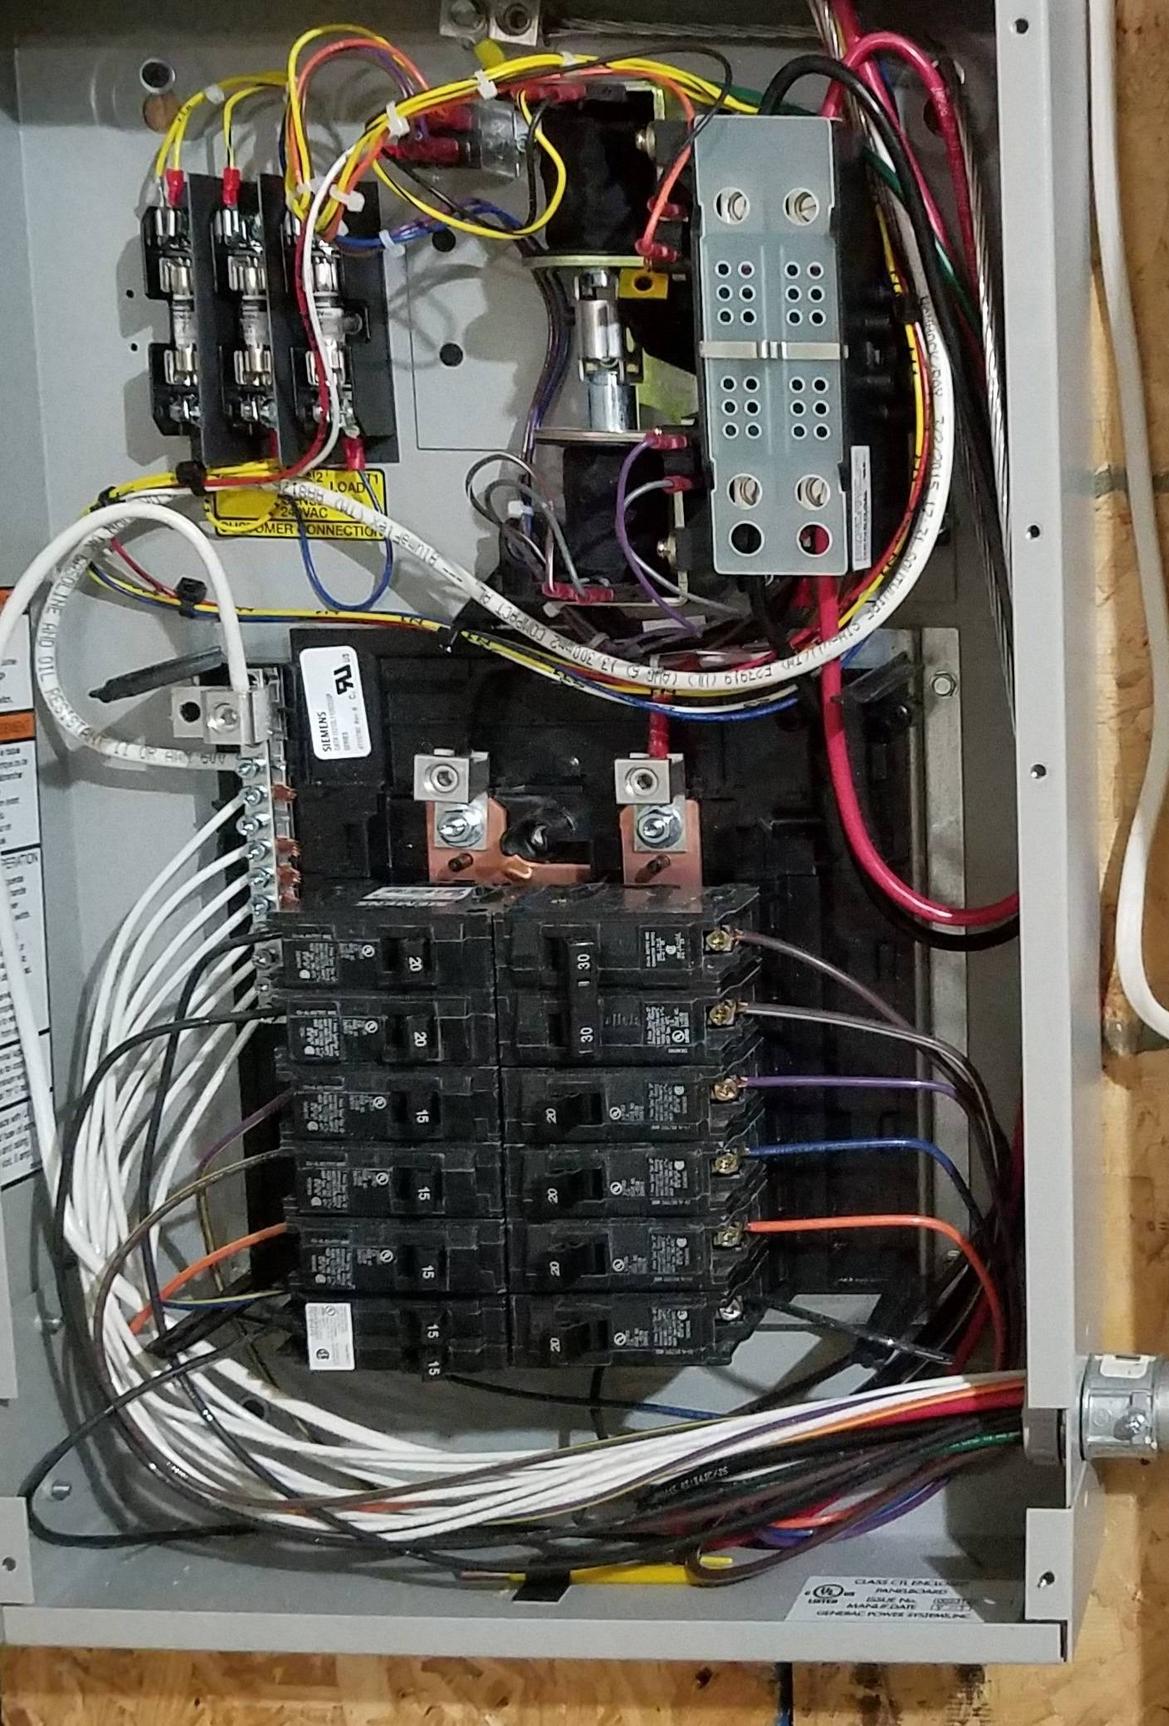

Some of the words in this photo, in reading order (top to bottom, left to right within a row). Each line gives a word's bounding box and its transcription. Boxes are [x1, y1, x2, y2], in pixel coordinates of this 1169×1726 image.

[329, 480, 365, 493] LOAD
[280, 506, 328, 519] 24VAC
[303, 523, 385, 537] ONNECTION
[39, 622, 57, 648] AND
[38, 656, 55, 683] OIL
[316, 711, 333, 752] SIEMENS
[409, 955, 422, 972] 20
[577, 953, 591, 971] 30
[414, 1031, 428, 1047] 20
[580, 1026, 594, 1044] 30
[415, 1108, 429, 1124] 15
[545, 1107, 557, 1124] 20
[417, 1186, 431, 1201] 15
[547, 1188, 559, 1204] 20
[421, 1264, 435, 1280] 15
[549, 1261, 561, 1277] 20
[426, 1324, 440, 1339] 15
[550, 1337, 562, 1353] 20
[427, 1360, 440, 1376] 15
